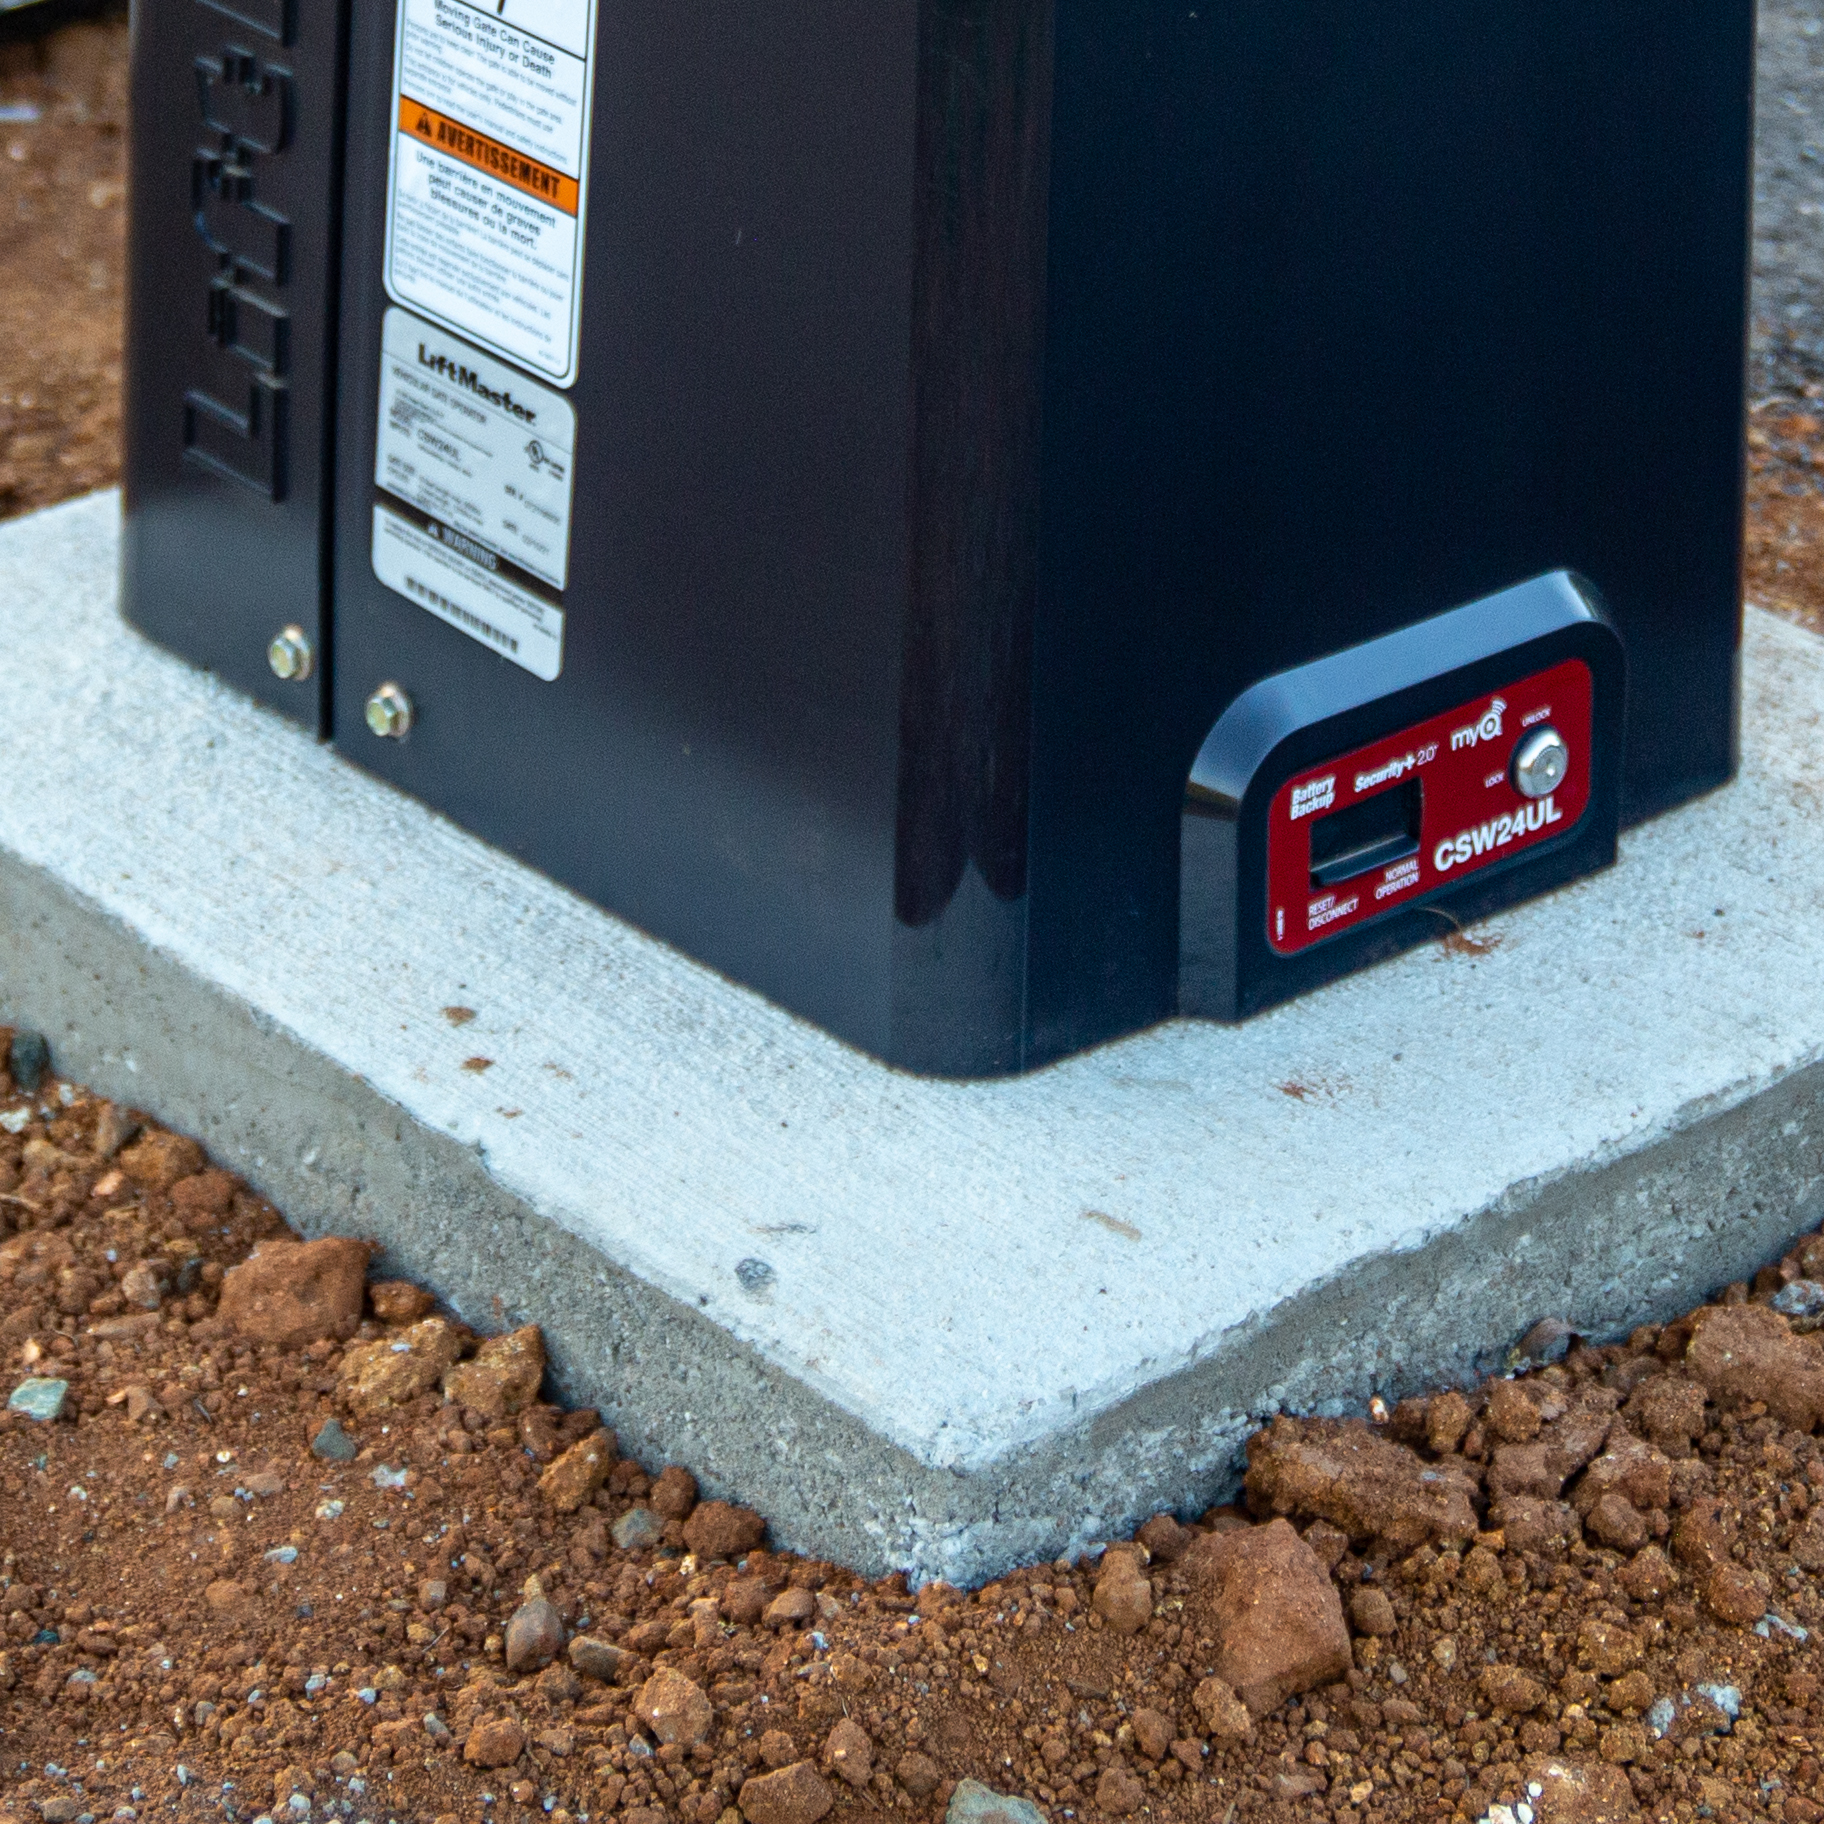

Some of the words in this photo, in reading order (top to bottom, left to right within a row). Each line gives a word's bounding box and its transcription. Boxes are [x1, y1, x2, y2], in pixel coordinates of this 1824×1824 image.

[435, 12, 472, 42] Serious
[476, 32, 505, 60] Injury
[508, 50, 518, 64] or
[522, 54, 551, 79] Death
[473, 15, 496, 37] Gate
[500, 28, 519, 48] Can
[522, 39, 555, 65] Cause
[437, 120, 561, 198] AVERTISSEMENT
[418, 342, 536, 426] LiftMaster
[443, 523, 499, 571] WARNING
[1451, 711, 1503, 751] myQ
[1291, 776, 1336, 805] Battery
[1485, 771, 1506, 789] LOCK
[1290, 791, 1335, 821] Backup
[1434, 795, 1563, 872] CSW24UL
[1376, 871, 1420, 900] OPERATION
[1385, 858, 1419, 882] NORMAL
[1308, 896, 1359, 931] DISCONNECT
